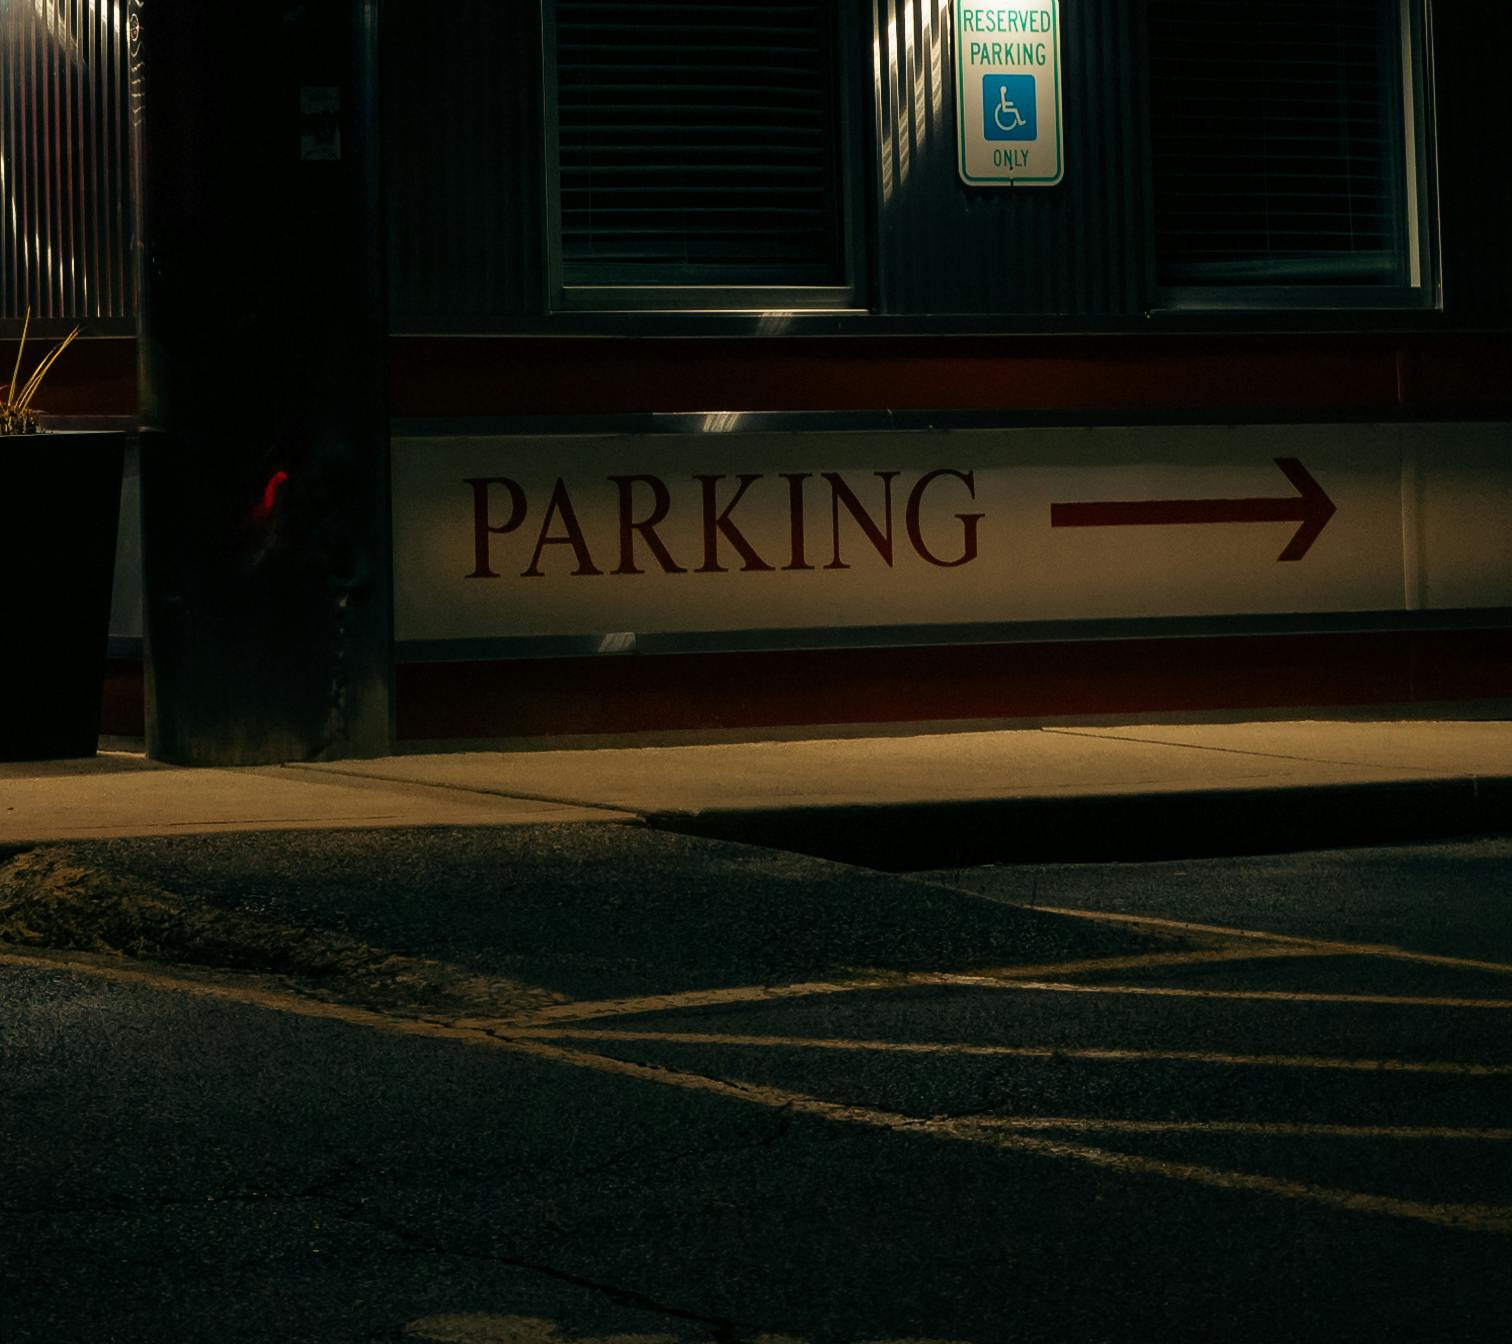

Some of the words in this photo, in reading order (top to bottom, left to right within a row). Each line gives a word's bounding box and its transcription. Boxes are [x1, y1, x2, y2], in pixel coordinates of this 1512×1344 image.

[963, 9, 1051, 33] RESERVED
[970, 42, 1046, 66] PARKING
[993, 149, 1029, 167] ONLY
[462, 467, 985, 579] PARKING
